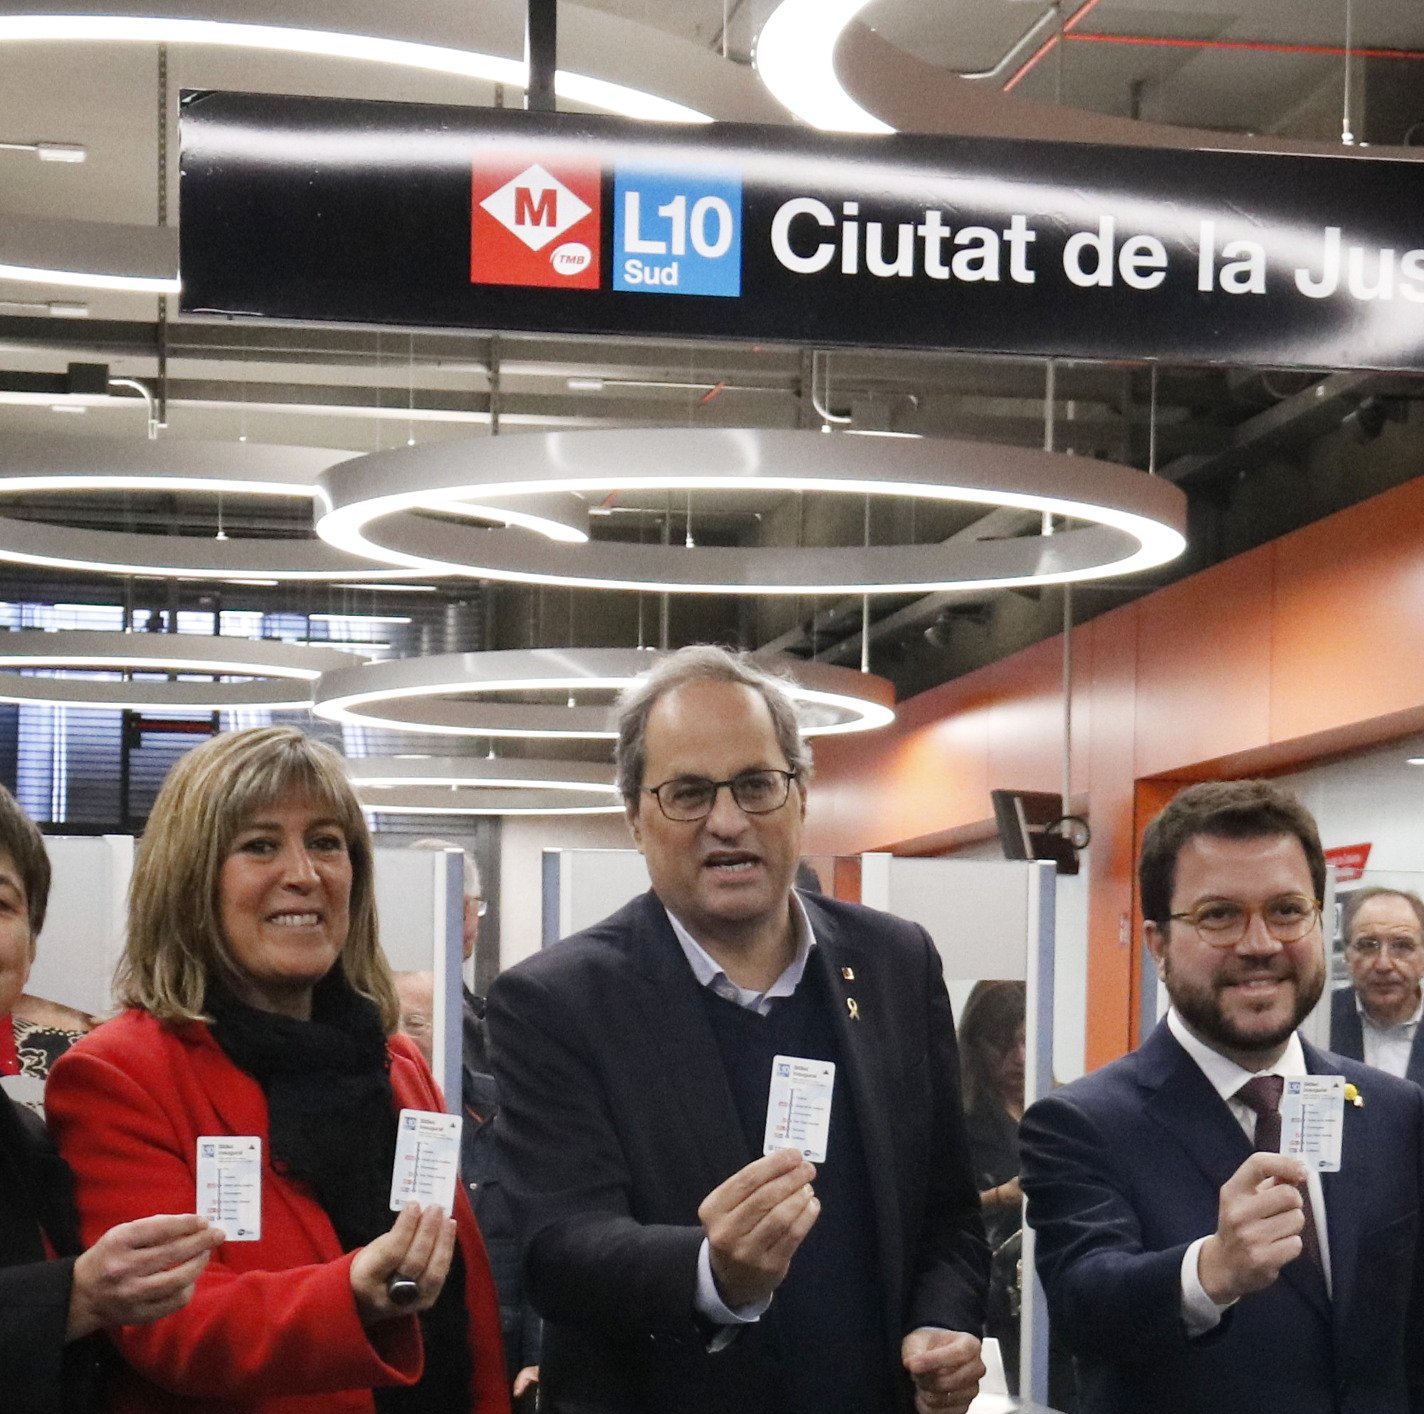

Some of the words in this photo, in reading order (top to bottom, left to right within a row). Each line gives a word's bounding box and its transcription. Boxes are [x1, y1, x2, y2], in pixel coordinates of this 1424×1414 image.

[514, 186, 557, 228] M
[624, 191, 733, 258] L10
[559, 249, 585, 265] TMB
[771, 197, 1036, 284] Ciutat
[1063, 215, 1168, 290] de
[1197, 220, 1266, 295] la
[623, 259, 678, 286] Sud
